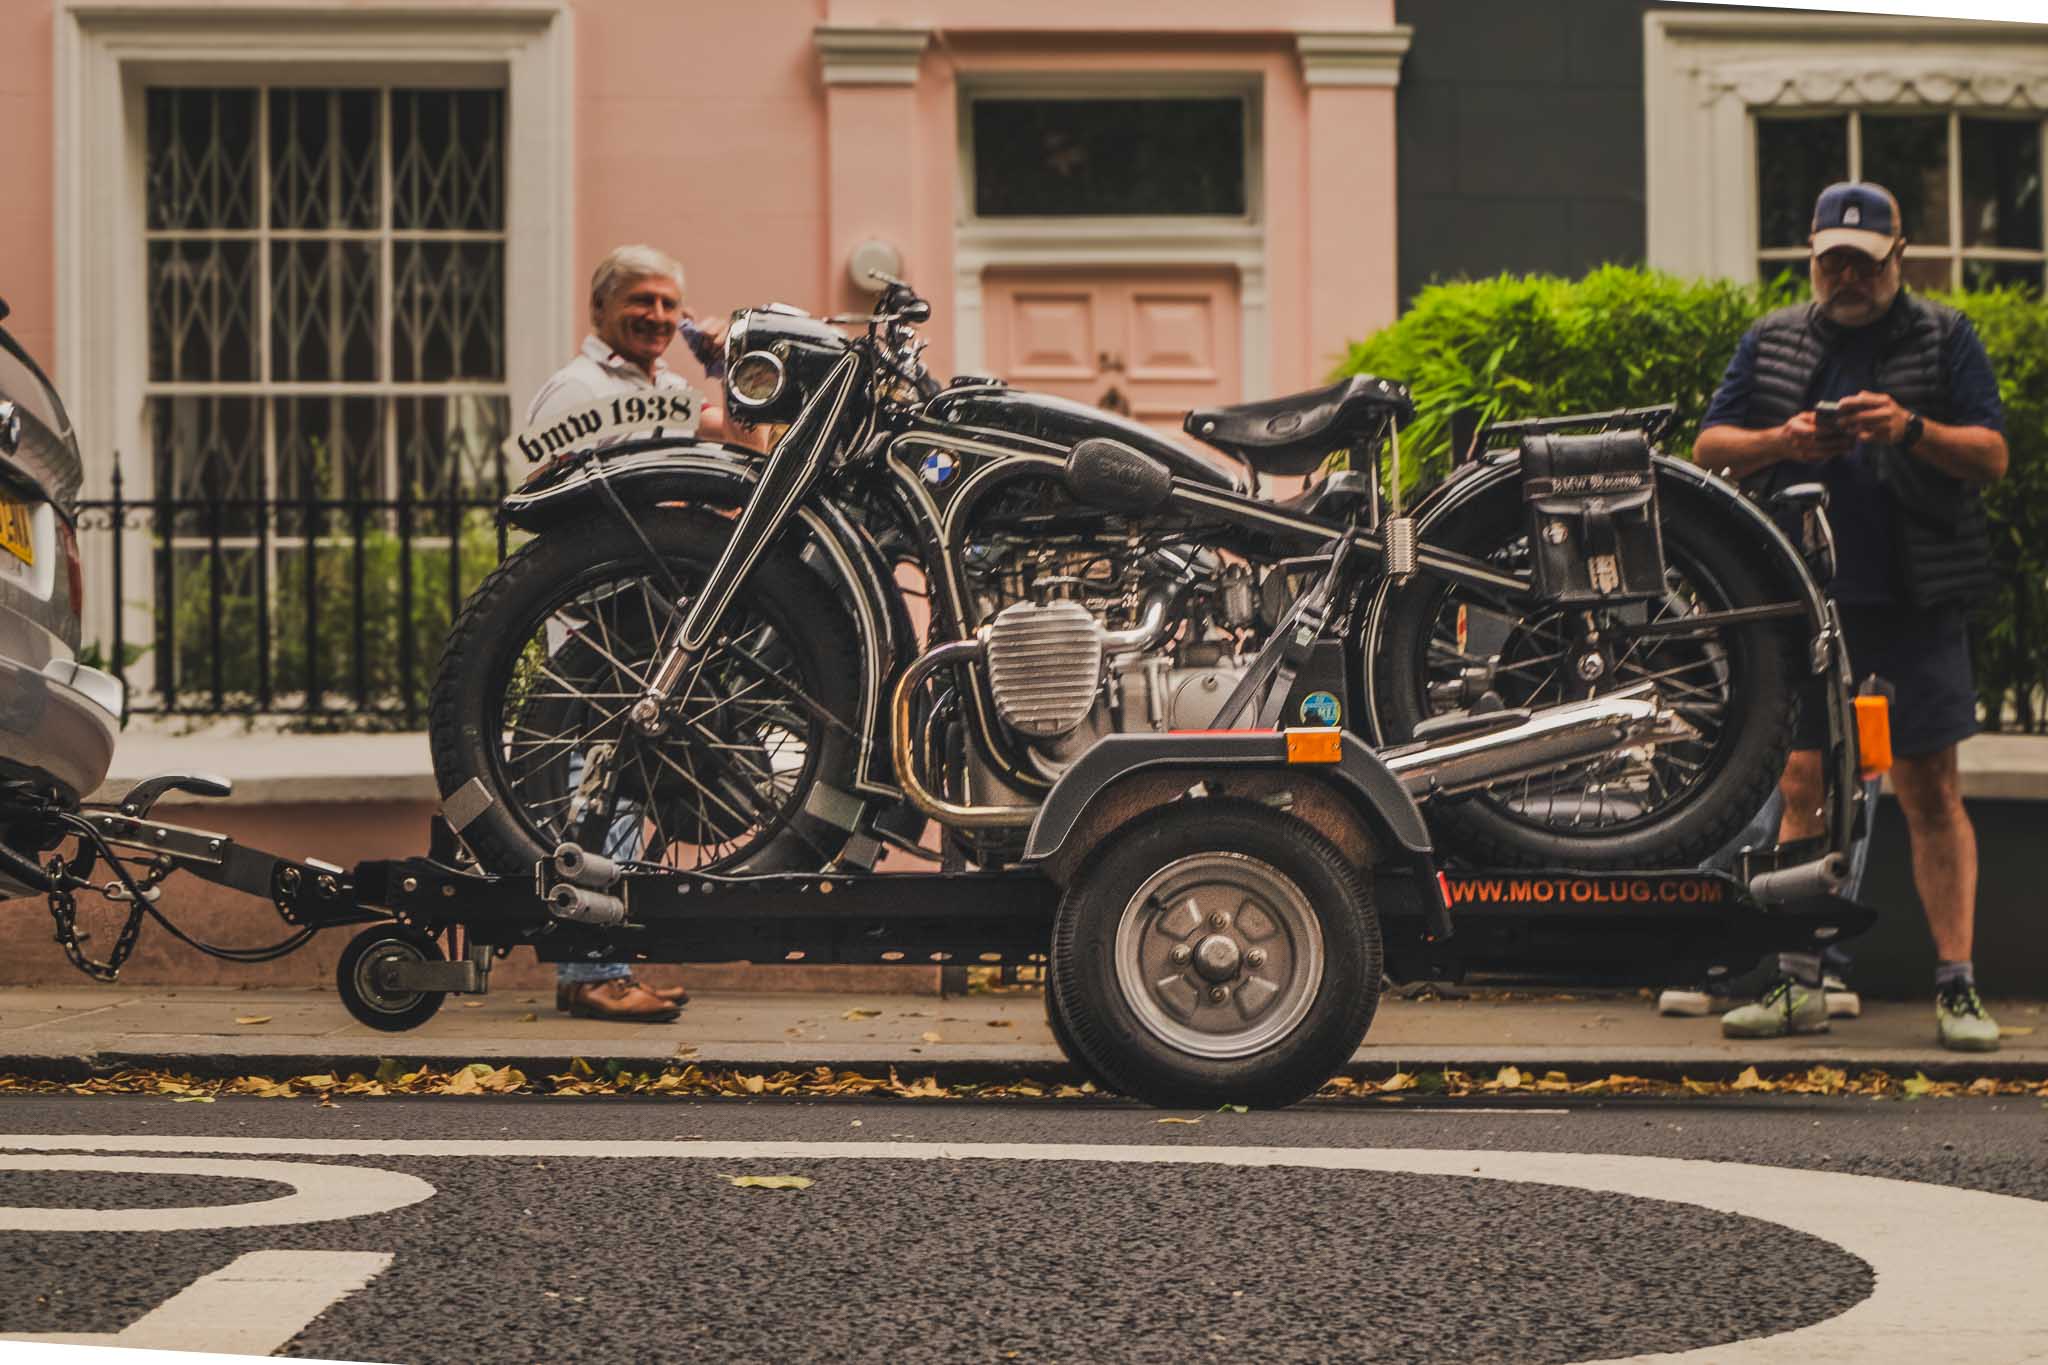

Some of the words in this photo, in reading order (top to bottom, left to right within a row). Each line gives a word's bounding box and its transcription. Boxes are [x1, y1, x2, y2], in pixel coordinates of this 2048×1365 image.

[517, 408, 603, 463] bmw
[610, 394, 692, 427] 1938
[1447, 879, 1722, 903] WW.MOTOLUG.COM
